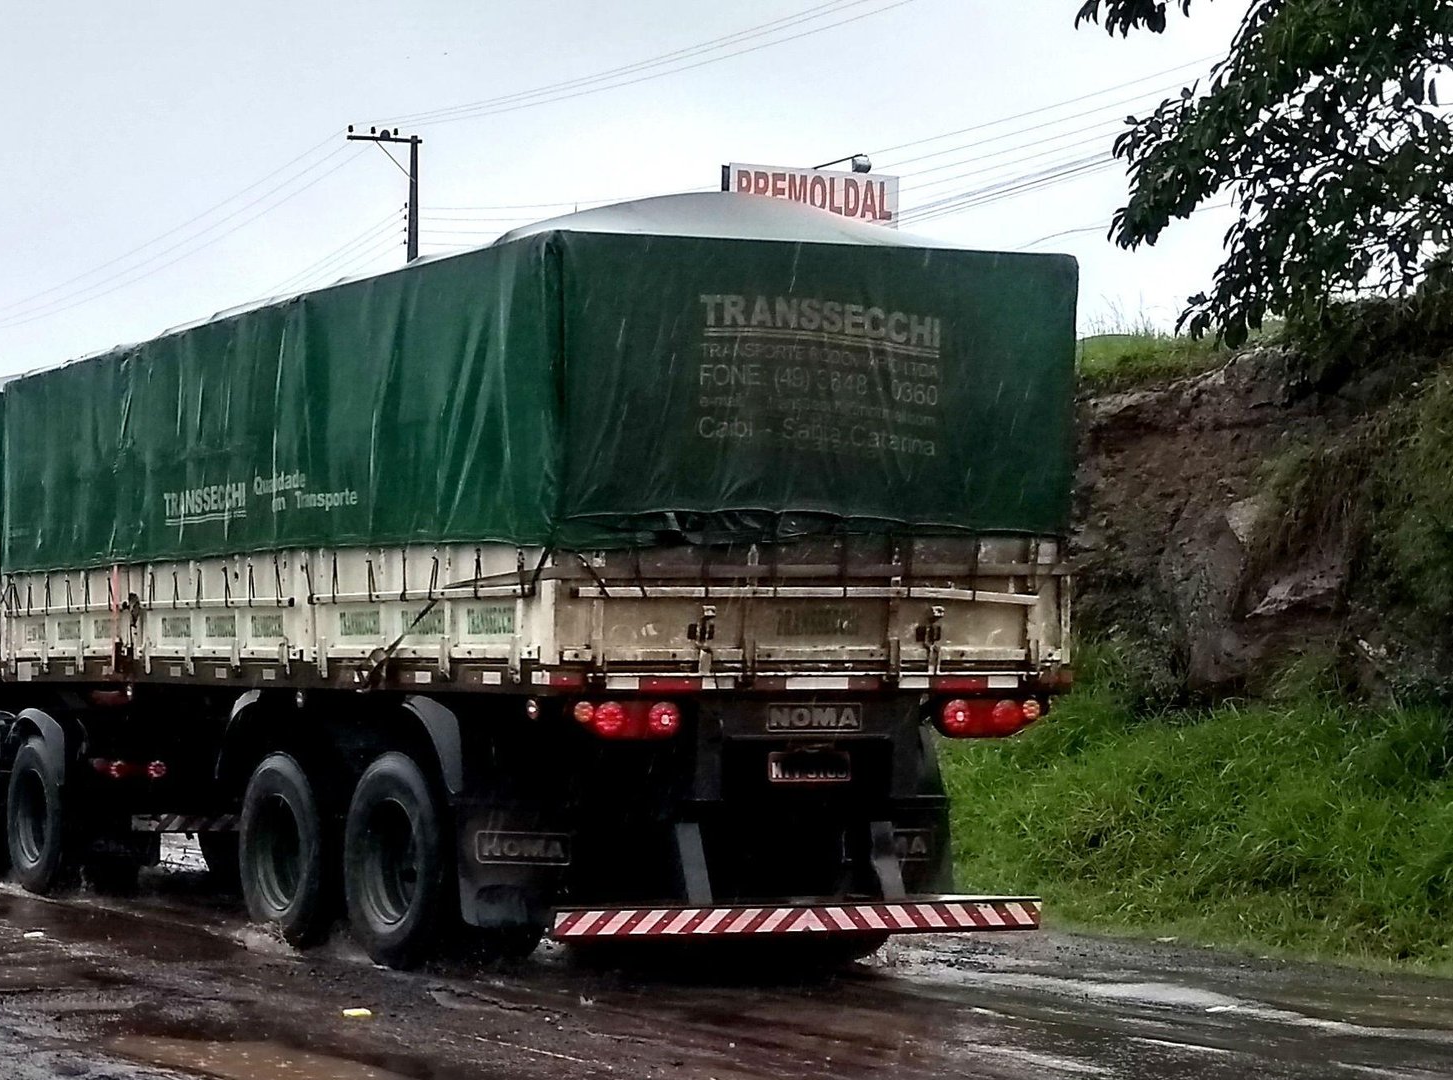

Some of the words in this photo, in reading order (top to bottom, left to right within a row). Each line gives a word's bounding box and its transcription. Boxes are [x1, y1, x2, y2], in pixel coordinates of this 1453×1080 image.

[737, 170, 893, 221] PREMOLDAL
[700, 294, 941, 348] TRANSSECCHI
[253, 469, 306, 496] Quaidade
[163, 481, 247, 517] TRANSSECCHI
[294, 488, 358, 512] Transporte
[769, 707, 859, 728] NOMA
